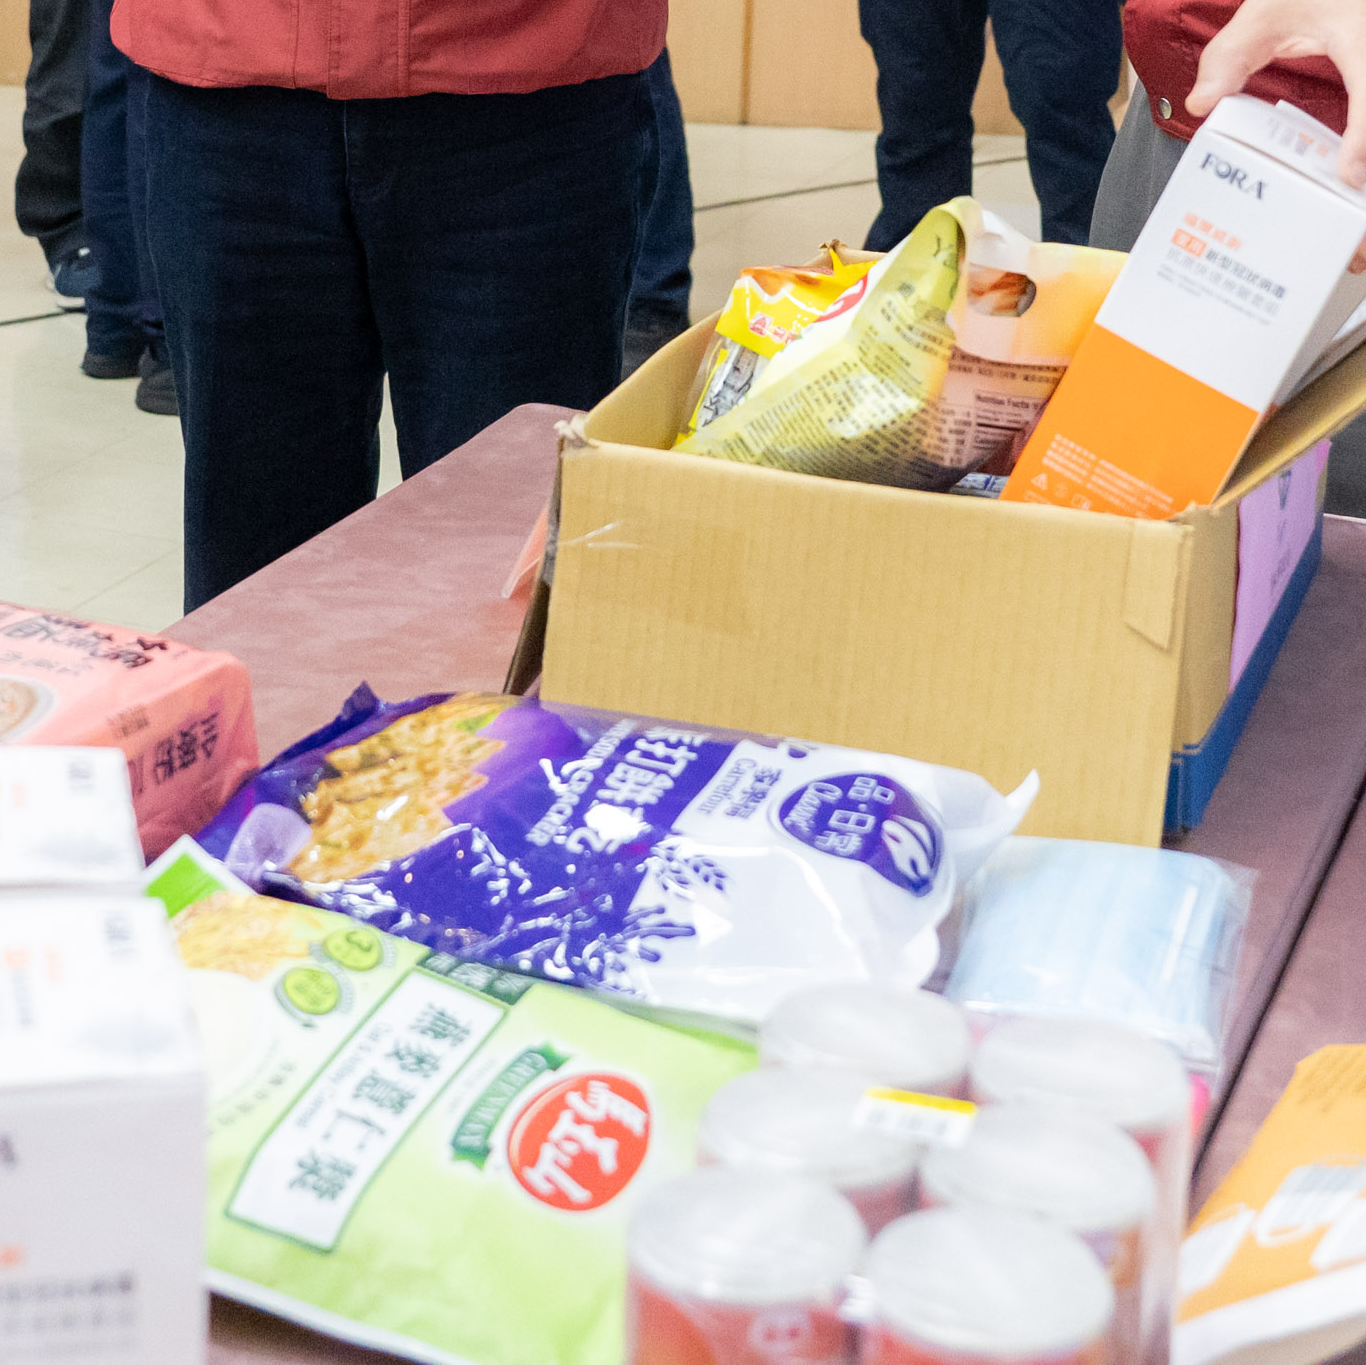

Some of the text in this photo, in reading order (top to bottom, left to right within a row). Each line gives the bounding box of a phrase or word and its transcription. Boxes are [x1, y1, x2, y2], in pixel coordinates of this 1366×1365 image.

[1200, 153, 1267, 201] FORA
[698, 757, 758, 816] Carrefour
[523, 1078, 649, 1205] 馬玉山
